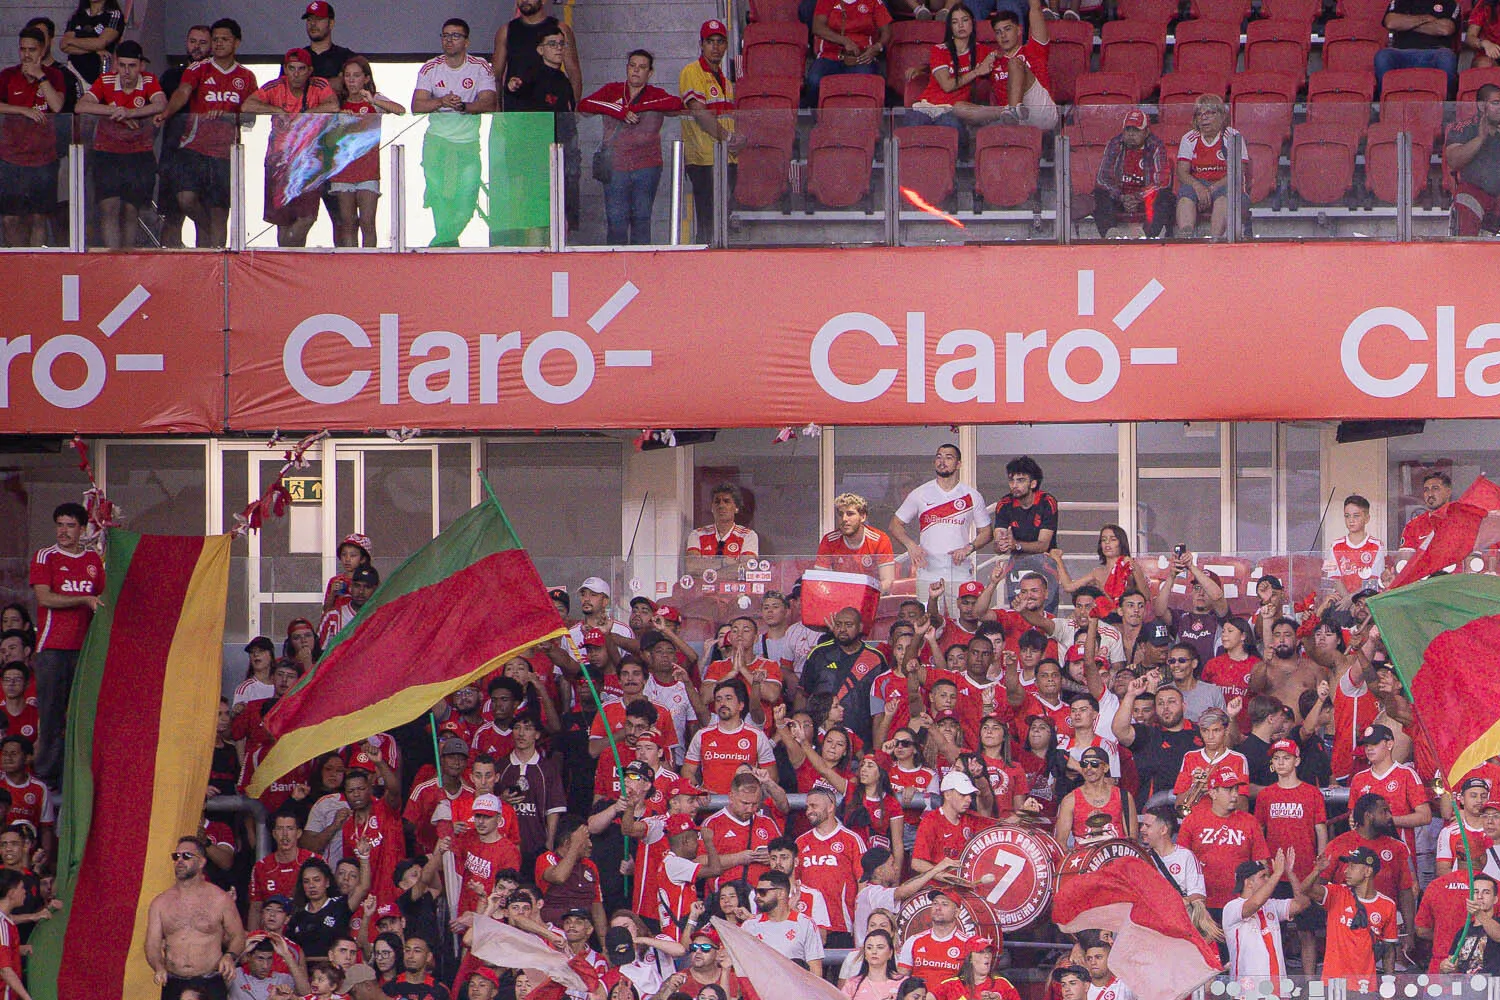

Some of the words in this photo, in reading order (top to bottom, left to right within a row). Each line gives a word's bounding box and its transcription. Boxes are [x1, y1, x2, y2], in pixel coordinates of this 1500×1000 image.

[205, 90, 241, 103] alfa
[283, 312, 596, 406] Claro
[809, 310, 1122, 403] Claro
[60, 580, 94, 593] alfa
[712, 750, 750, 762] banrisul
[802, 854, 839, 868] alfa
[970, 830, 1013, 854] GUARDA
[1015, 832, 1049, 879] POPULAR
[985, 848, 1027, 906] 7
[922, 960, 960, 971] banrisul
